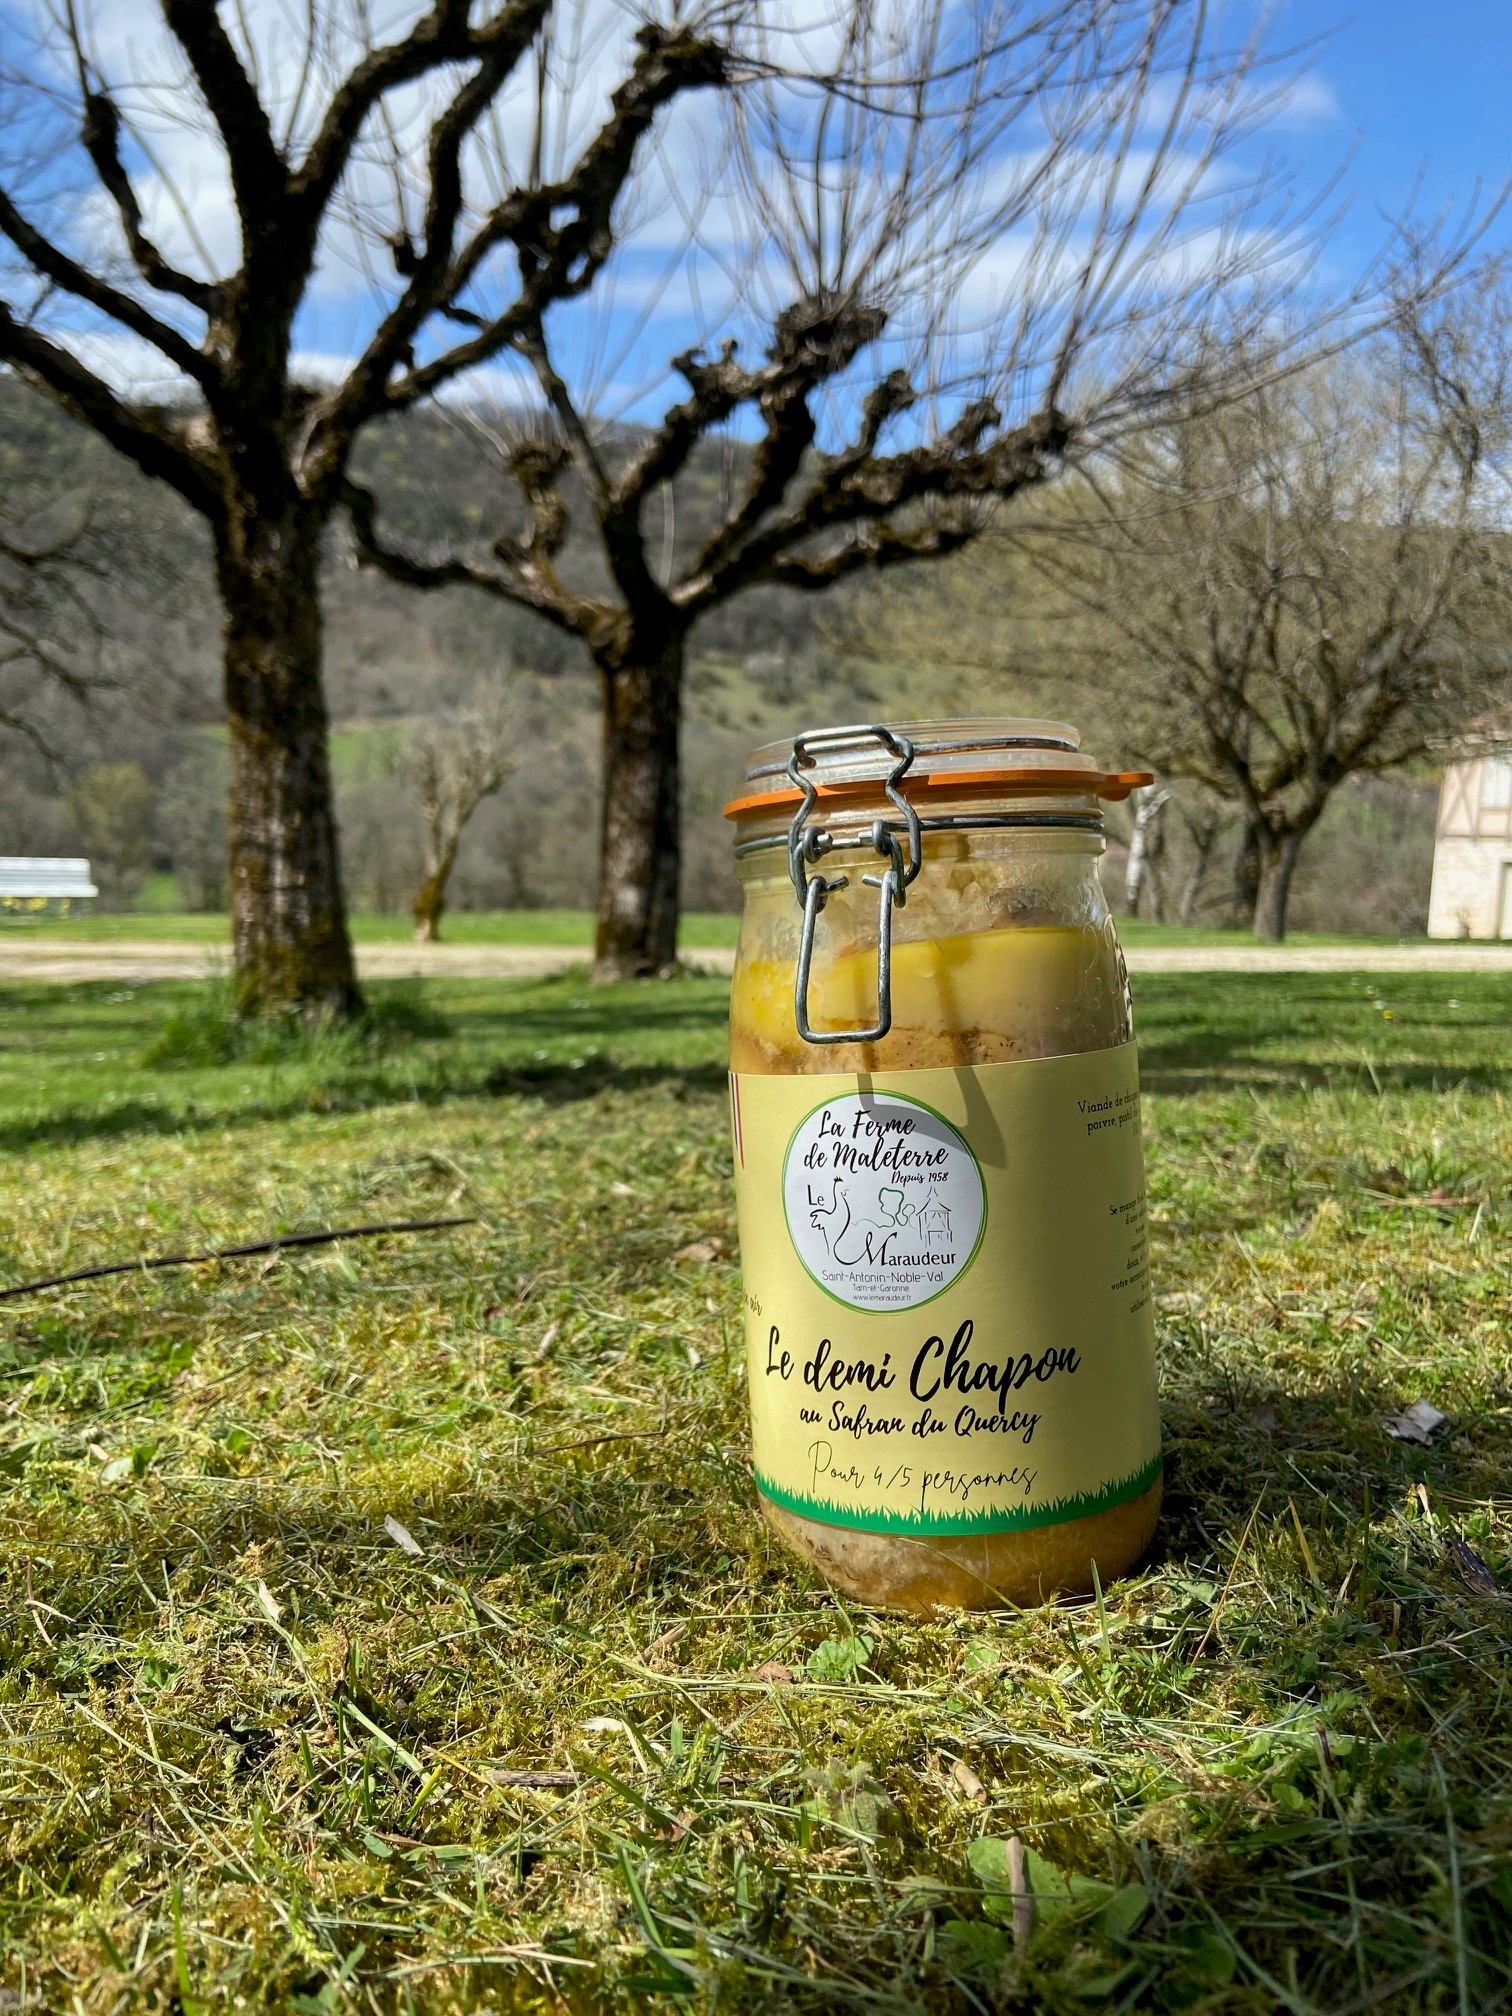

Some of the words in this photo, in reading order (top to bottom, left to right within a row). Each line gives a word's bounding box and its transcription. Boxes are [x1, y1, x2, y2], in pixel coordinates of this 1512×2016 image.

[1077, 1095, 1113, 1115] Viande
[818, 1110, 846, 1138] La
[851, 1110, 917, 1139] Ferme
[804, 1142, 827, 1169] de
[832, 1137, 949, 1174] Maleterre
[807, 1184, 825, 1206] Le
[891, 1171, 925, 1187] Depuis
[928, 1172, 949, 1182] 1958
[865, 1231, 956, 1266] Maraudeur
[766, 1325, 794, 1380] Le
[803, 1338, 896, 1392] demi
[909, 1319, 1082, 1415] Chapon
[800, 1407, 823, 1424] au
[828, 1400, 905, 1440] Safran
[911, 1408, 947, 1438] du
[954, 1405, 1042, 1443] Quercy
[808, 1440, 865, 1493] Pour
[922, 1466, 1039, 1512] personnes
